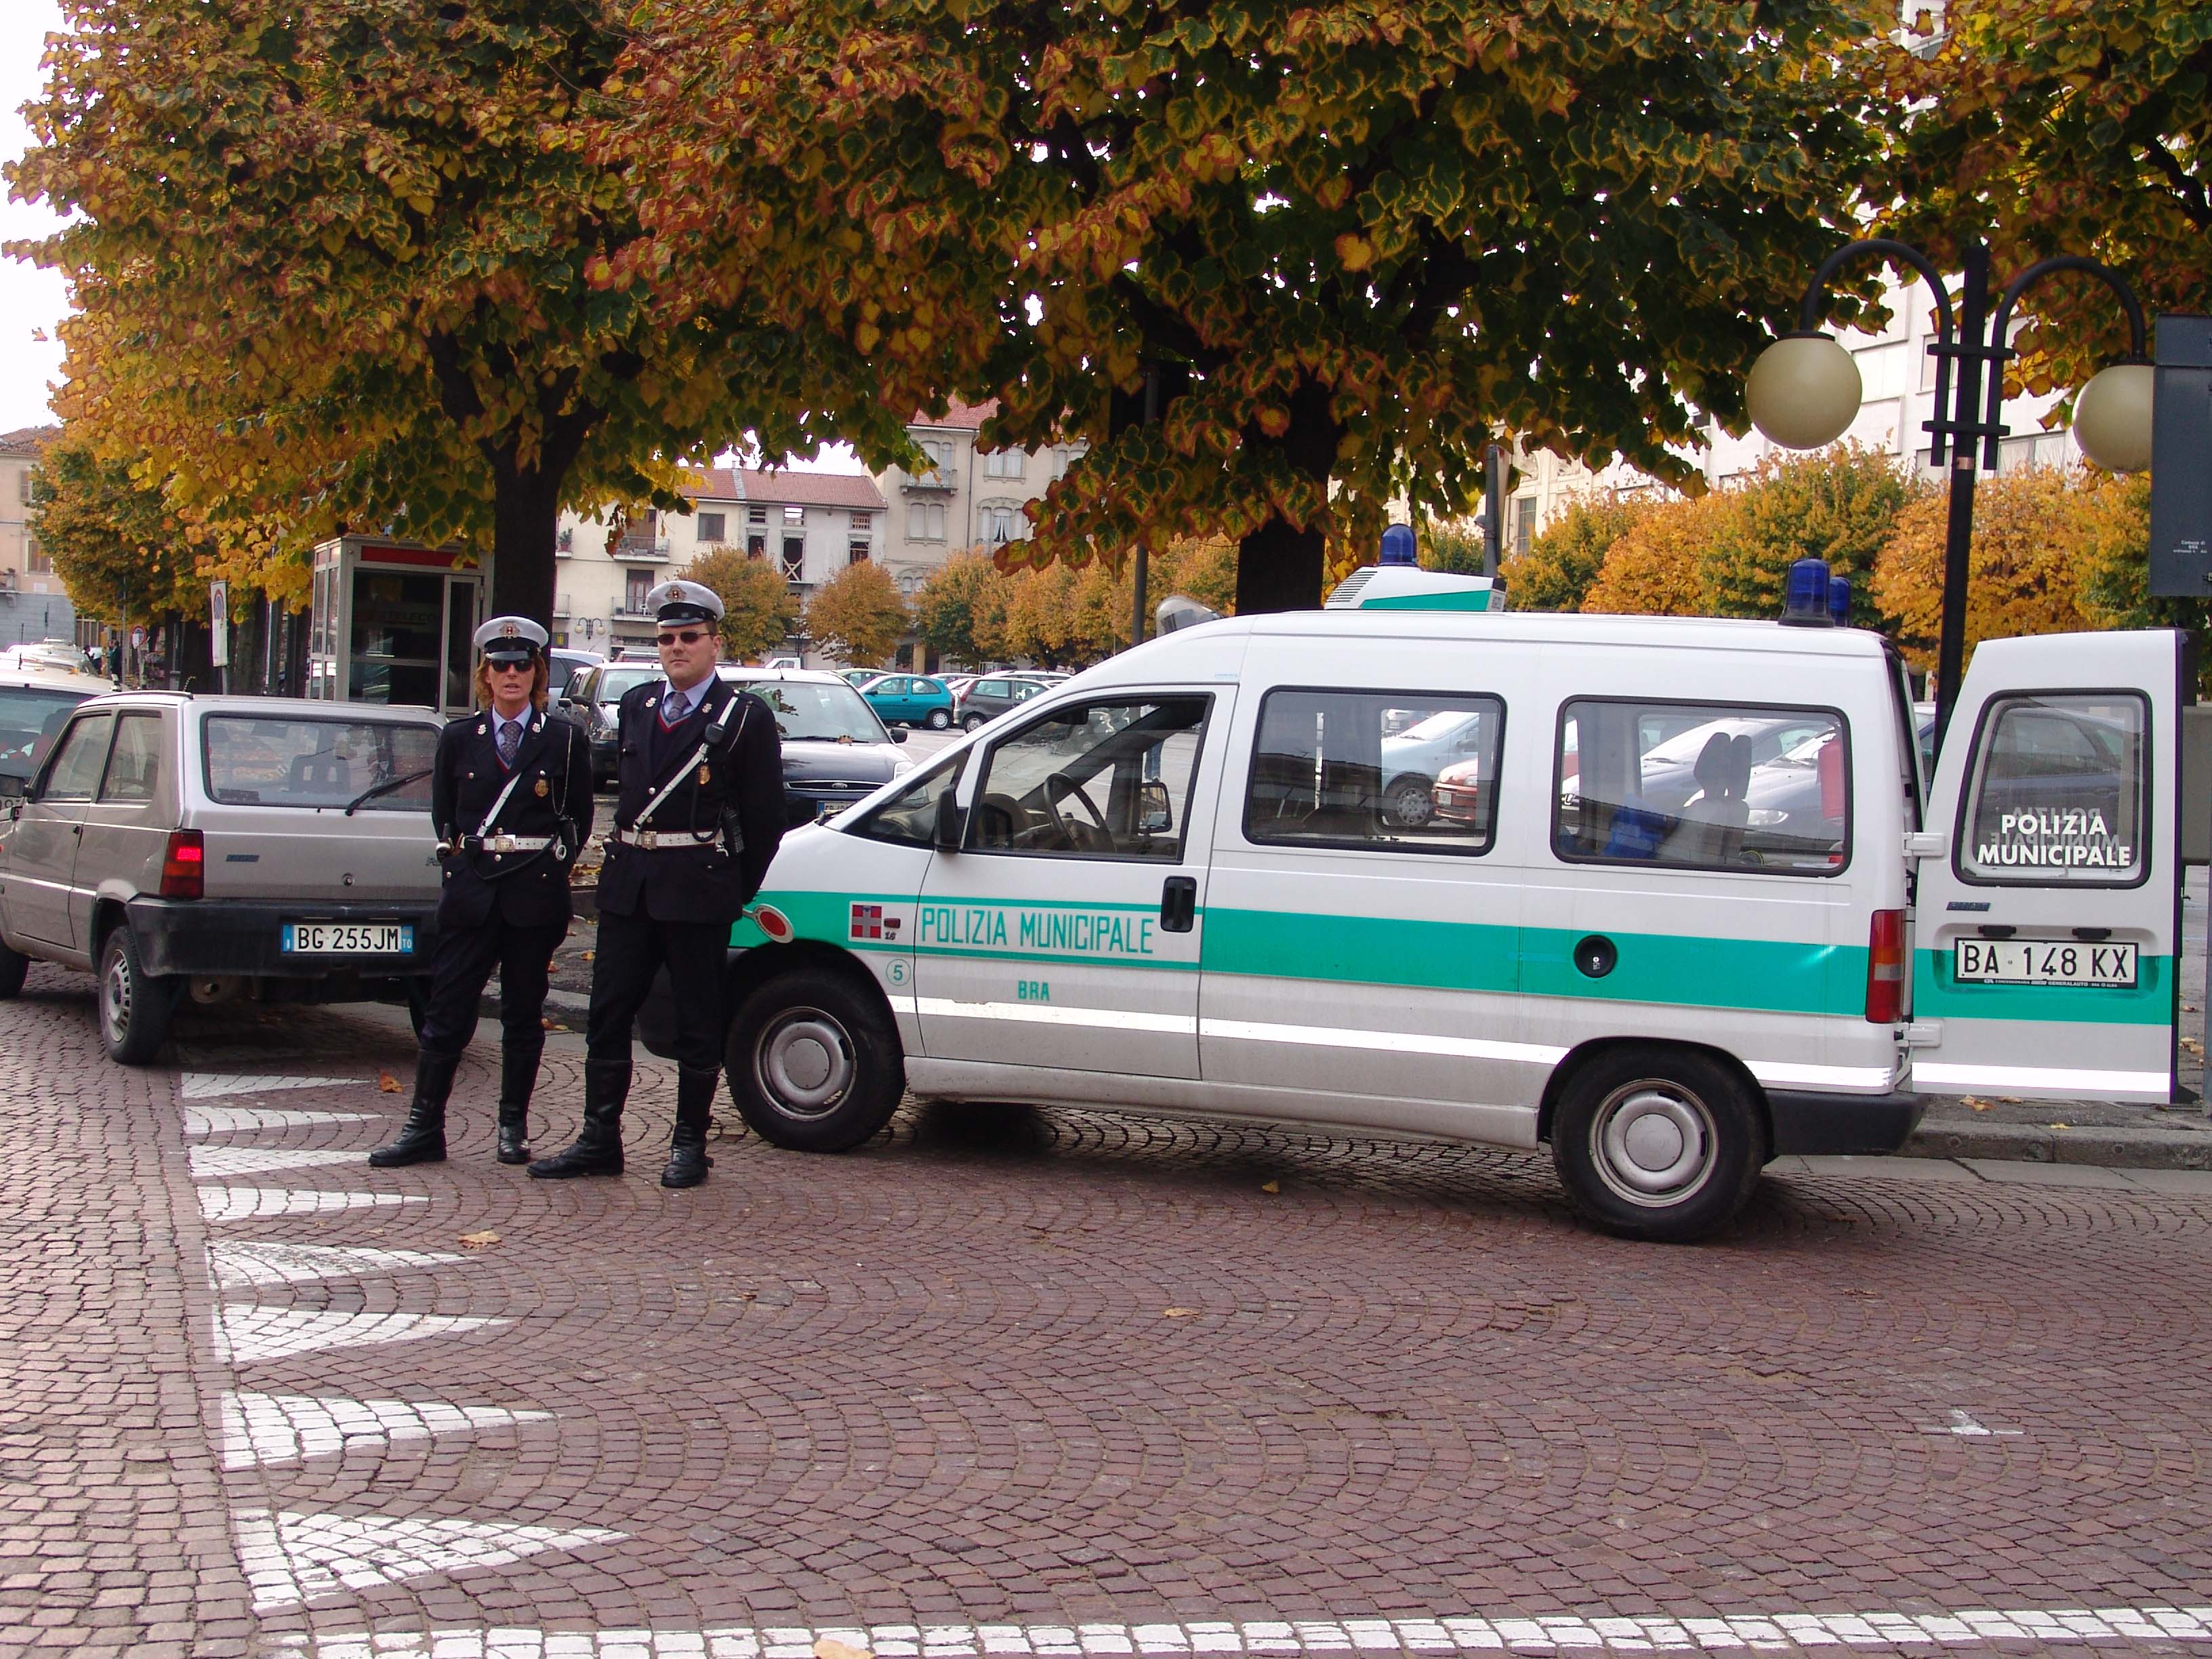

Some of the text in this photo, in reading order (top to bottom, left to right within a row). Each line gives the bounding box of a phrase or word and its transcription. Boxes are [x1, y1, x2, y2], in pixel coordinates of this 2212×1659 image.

[2001, 815, 2108, 835] POLIZIA
[1977, 844, 2131, 866] MUNICIPALE
[298, 927, 398, 949] BG 255JM
[922, 907, 1154, 954] POLIZIA MUNICIPALE
[403, 939, 412, 947] TO
[1964, 945, 2127, 977] BA 148 KX
[893, 964, 903, 981] 5
[1018, 980, 1050, 1001] BRA
